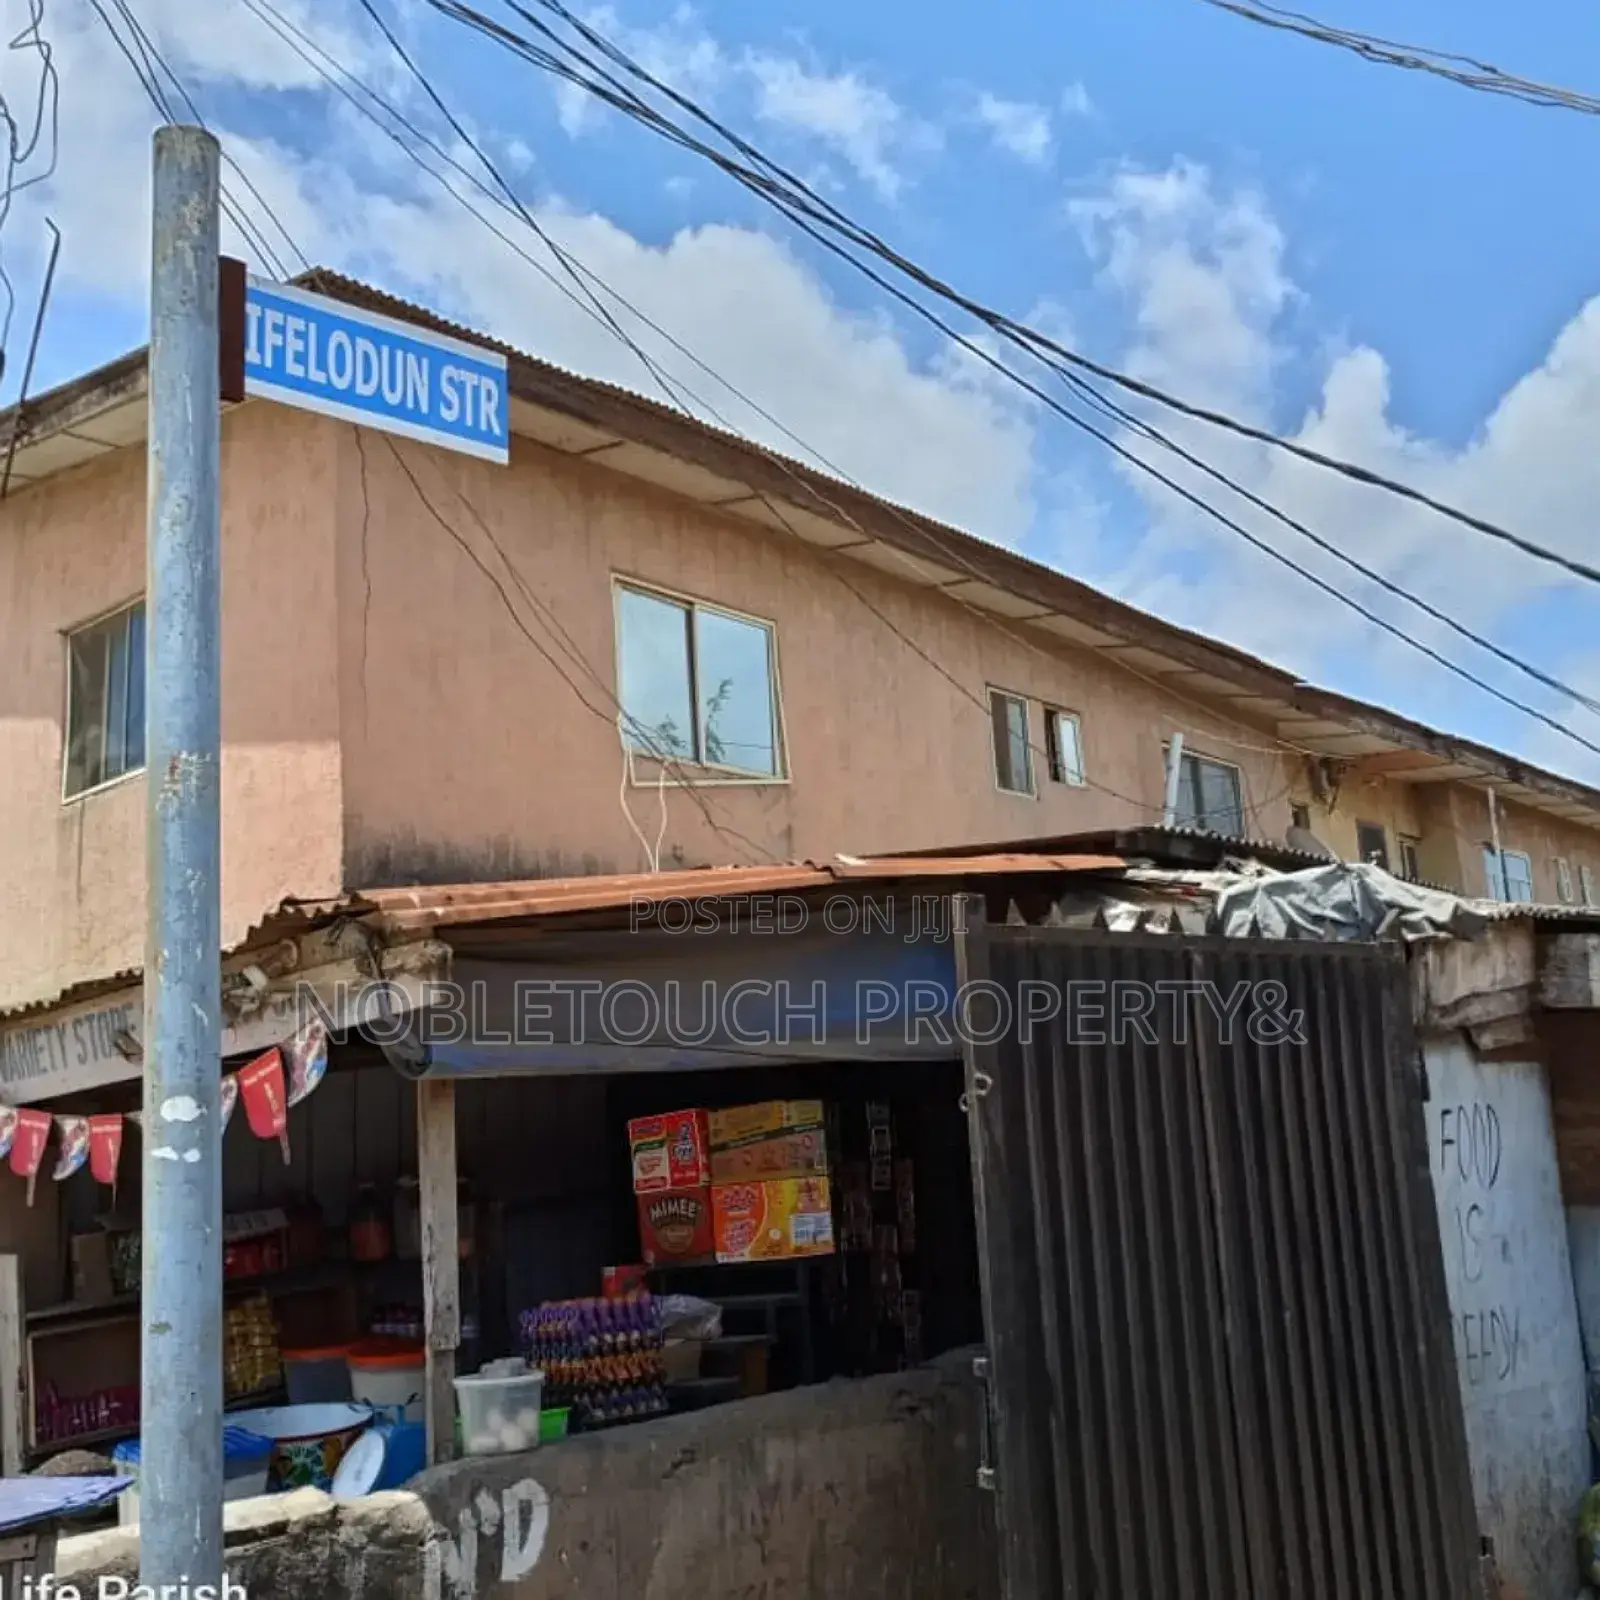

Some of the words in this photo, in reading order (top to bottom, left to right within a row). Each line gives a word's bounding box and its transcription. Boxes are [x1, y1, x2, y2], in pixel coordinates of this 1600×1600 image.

[245, 302, 429, 413] IFELODUN
[439, 364, 500, 436] STR
[1440, 1102, 1501, 1190] FOOD
[1455, 1203, 1484, 1284] IS
